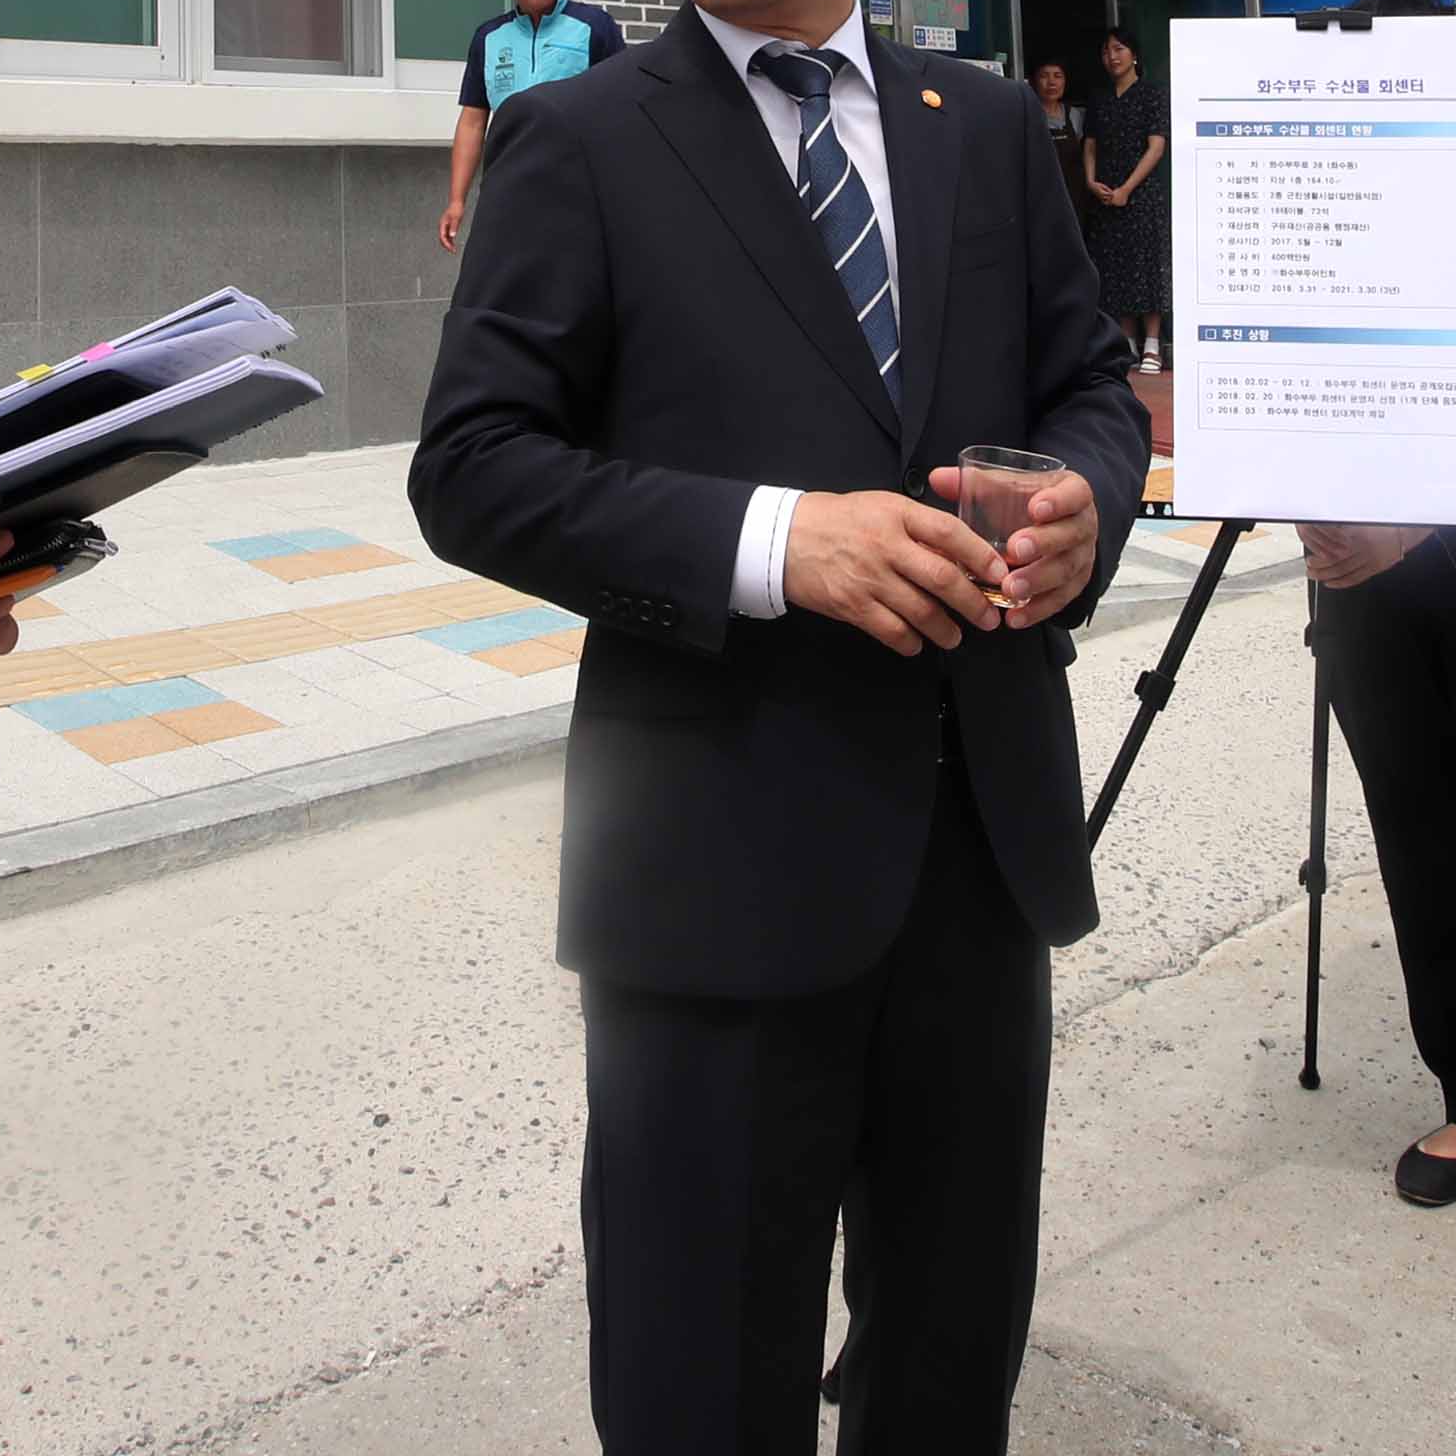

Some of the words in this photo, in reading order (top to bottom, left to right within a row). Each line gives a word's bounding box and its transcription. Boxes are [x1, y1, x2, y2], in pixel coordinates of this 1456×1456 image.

[1257, 79, 1316, 94] 화수부두
[1325, 79, 1369, 94] 수산물
[1379, 79, 1423, 94] 회센터
[1232, 124, 1273, 136] 화수부두
[1279, 124, 1309, 136] 수산물
[1315, 124, 1346, 136] 회센터
[1248, 329, 1269, 341] 상황
